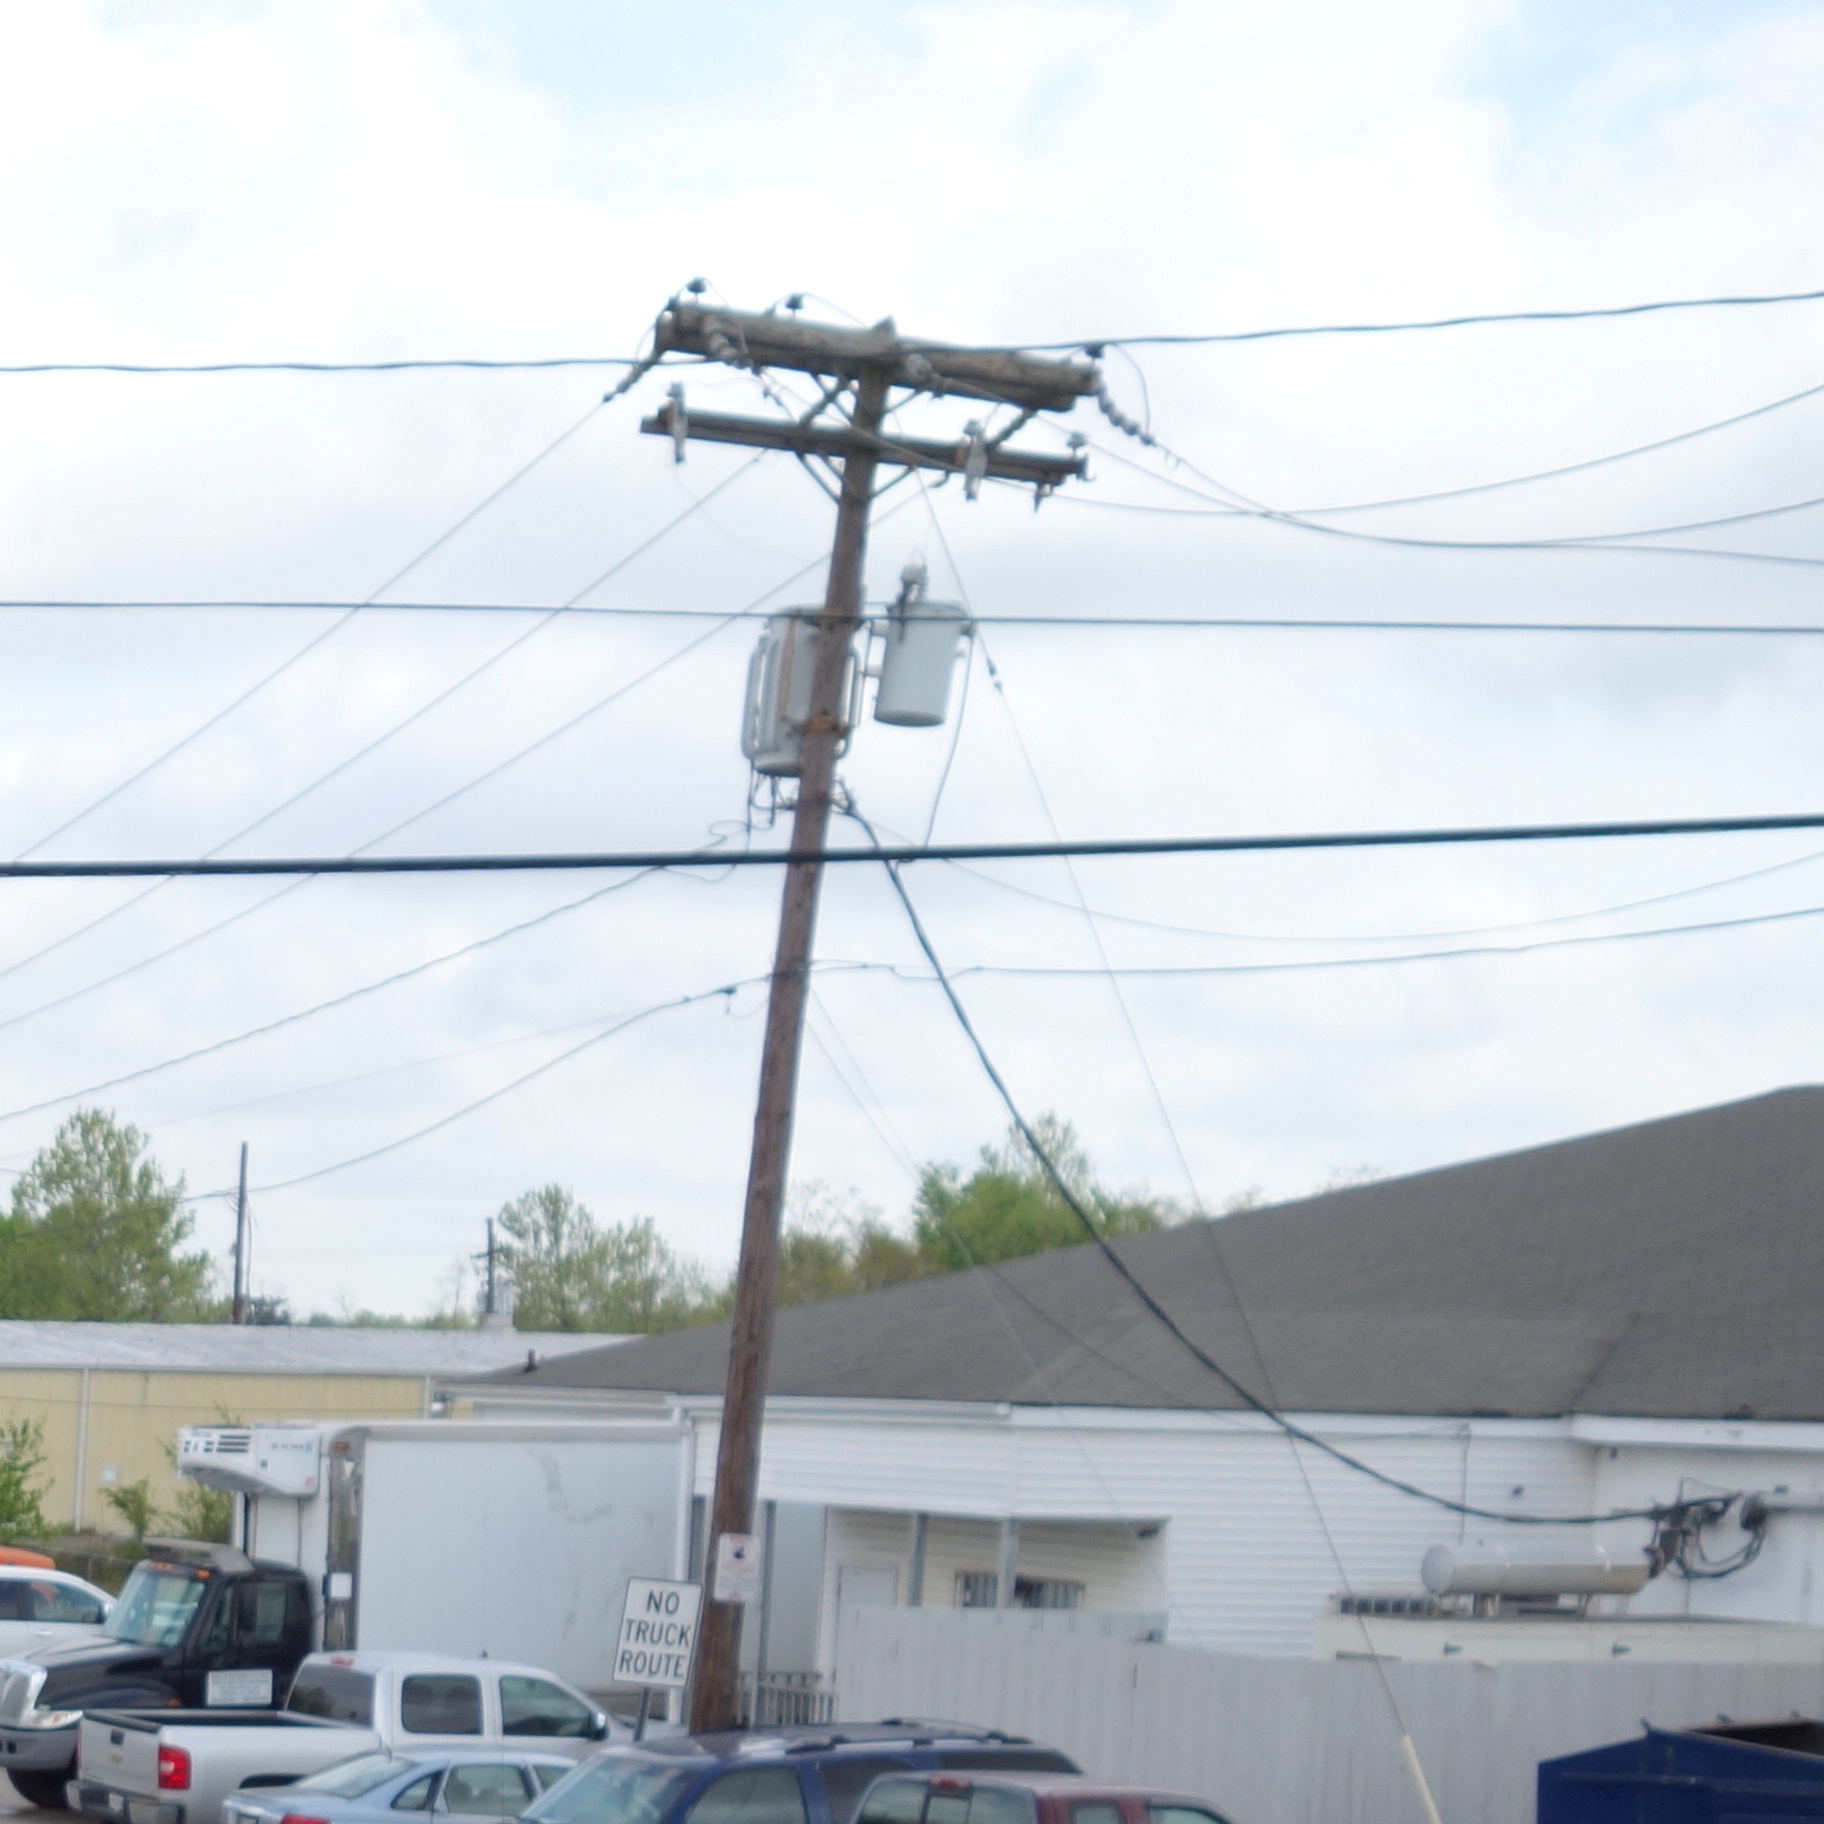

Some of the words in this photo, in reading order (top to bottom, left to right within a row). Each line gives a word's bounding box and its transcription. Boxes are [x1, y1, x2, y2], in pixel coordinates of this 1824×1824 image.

[646, 1589, 680, 1615] NO
[625, 1618, 692, 1647] TRUCK
[618, 1649, 687, 1678] ROUTE
